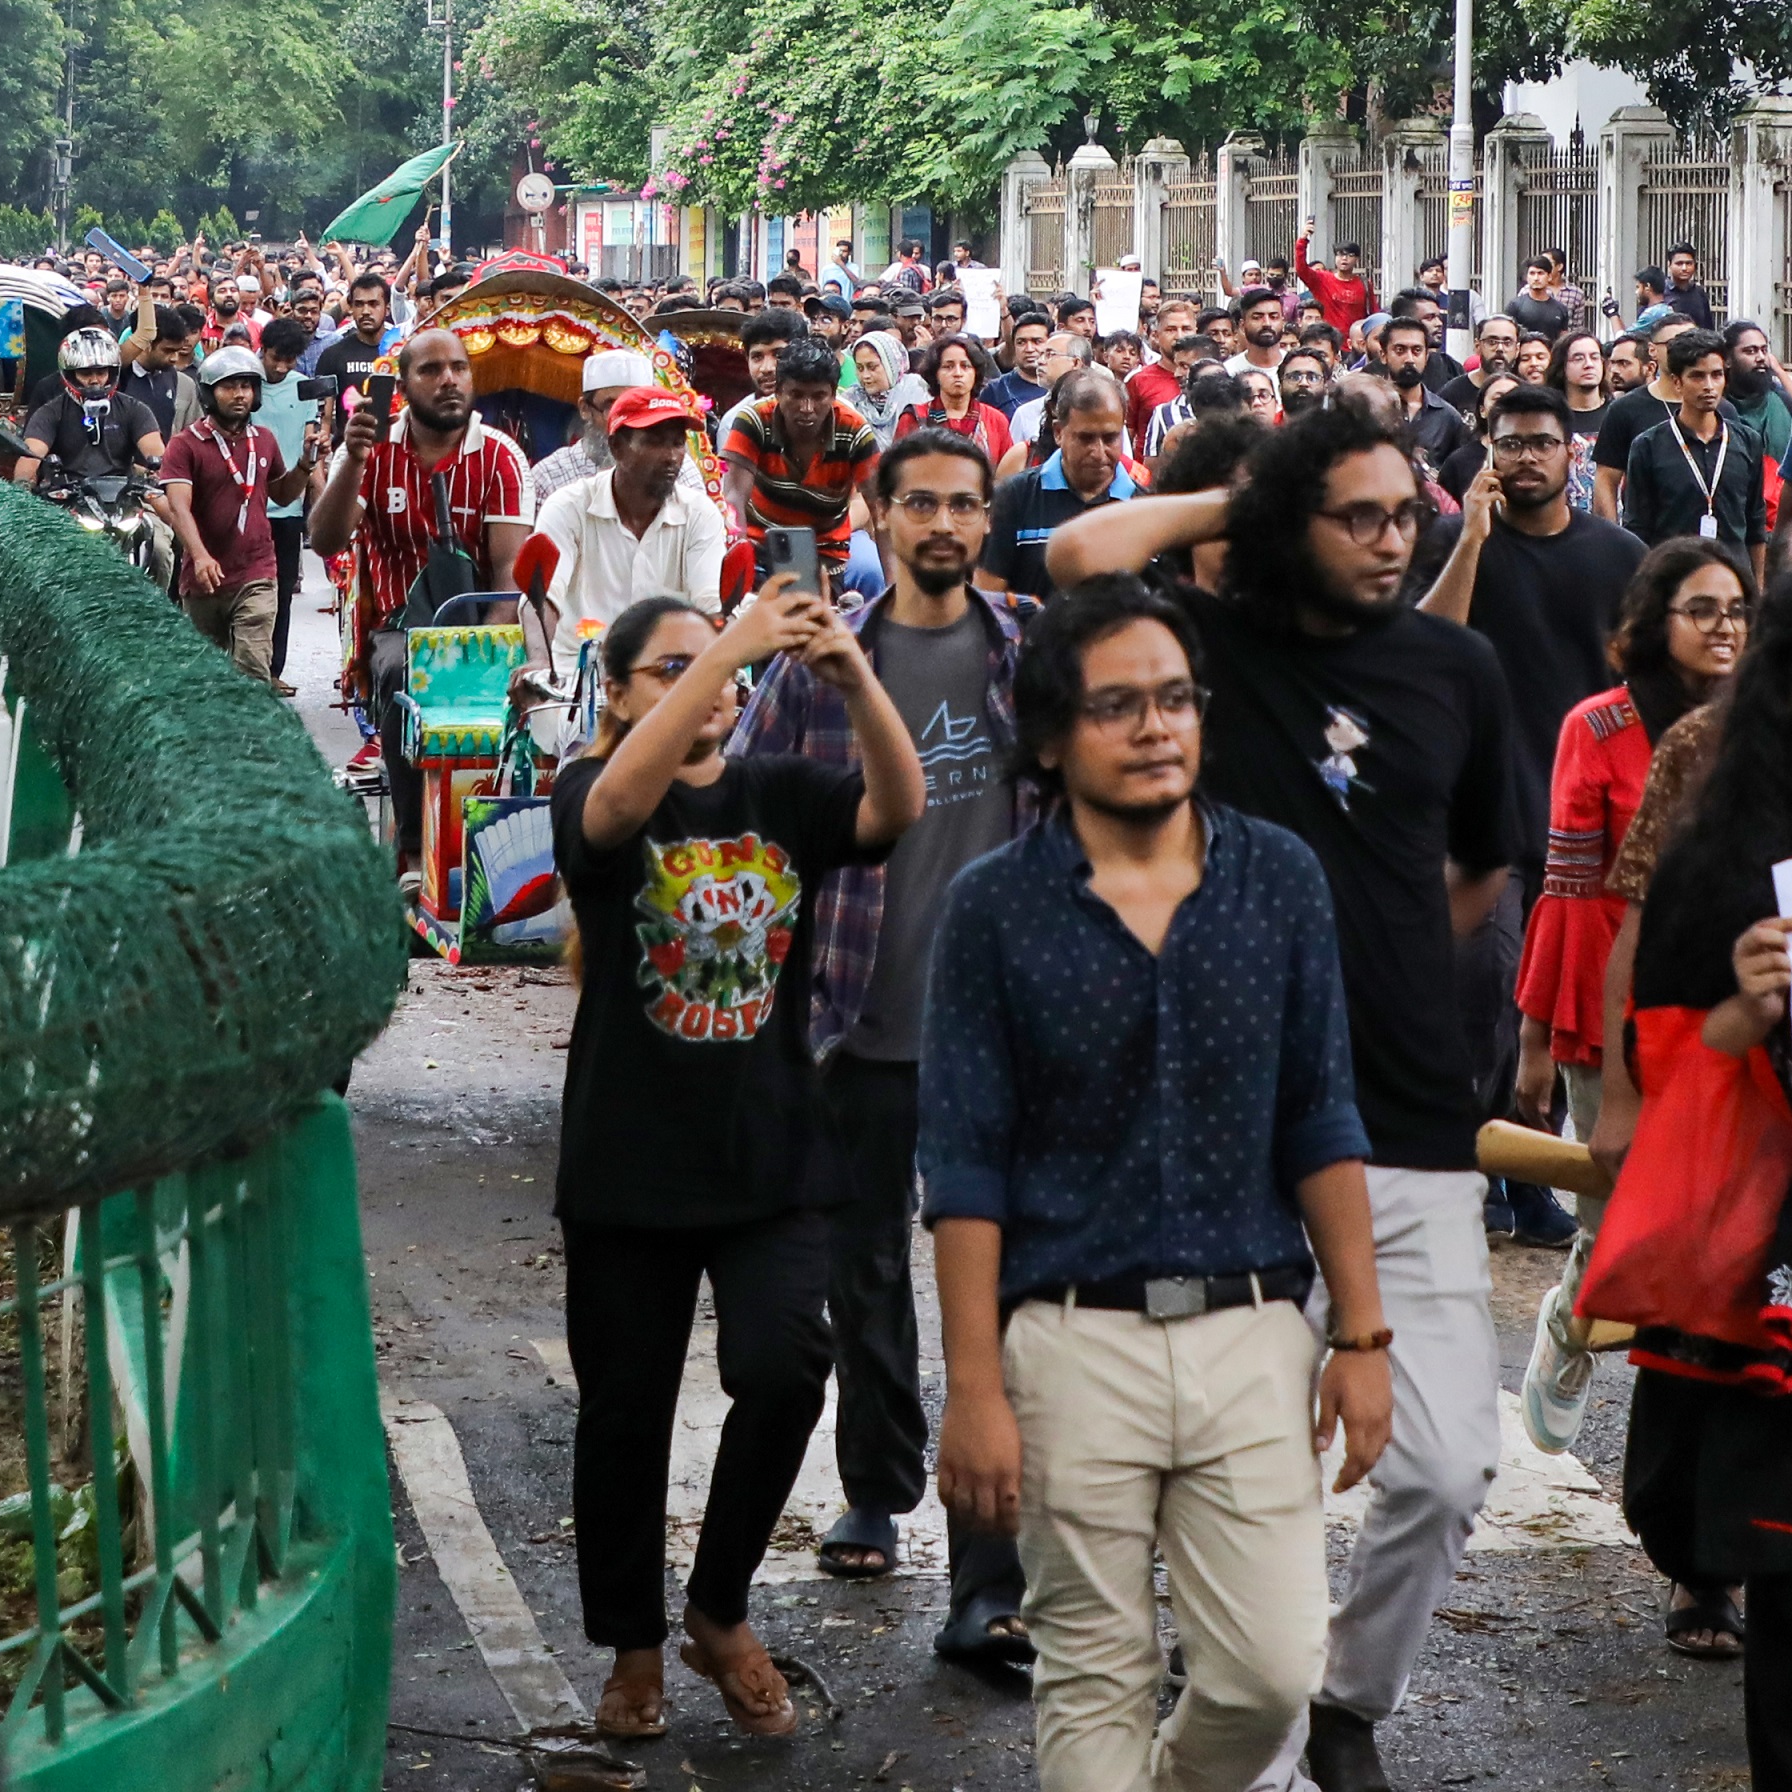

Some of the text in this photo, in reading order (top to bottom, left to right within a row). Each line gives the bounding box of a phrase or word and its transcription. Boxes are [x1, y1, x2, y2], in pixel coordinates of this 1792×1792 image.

[346, 361, 375, 373] HIGH
[387, 487, 407, 514] B
[925, 765, 987, 791] ERN
